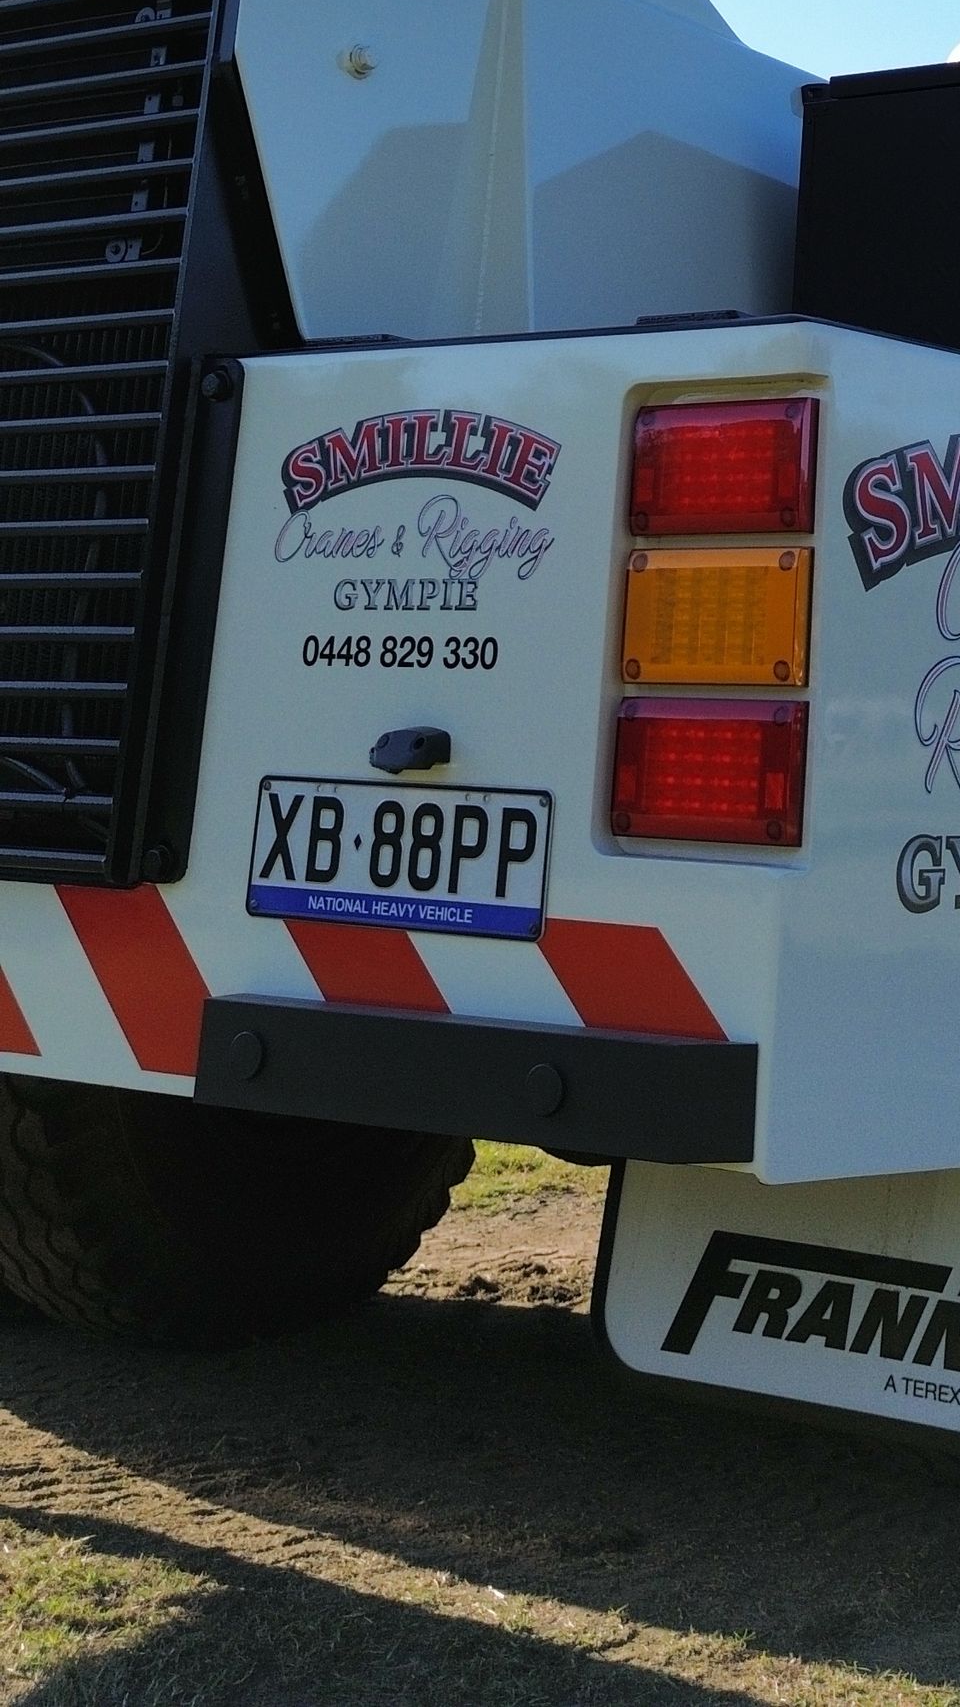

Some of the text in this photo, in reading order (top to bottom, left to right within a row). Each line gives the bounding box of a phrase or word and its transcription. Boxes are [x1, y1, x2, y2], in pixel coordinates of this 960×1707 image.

[281, 409, 561, 513] SMILLIE
[274, 494, 554, 580] Cranes & Rigging
[333, 578, 478, 611] GYMPIE
[302, 635, 498, 670] 0448 829 330
[308, 895, 473, 924] NATIONAL HEAVY VEHICLE
[884, 1374, 897, 1393] A
[902, 1377, 960, 1406] TEREX
